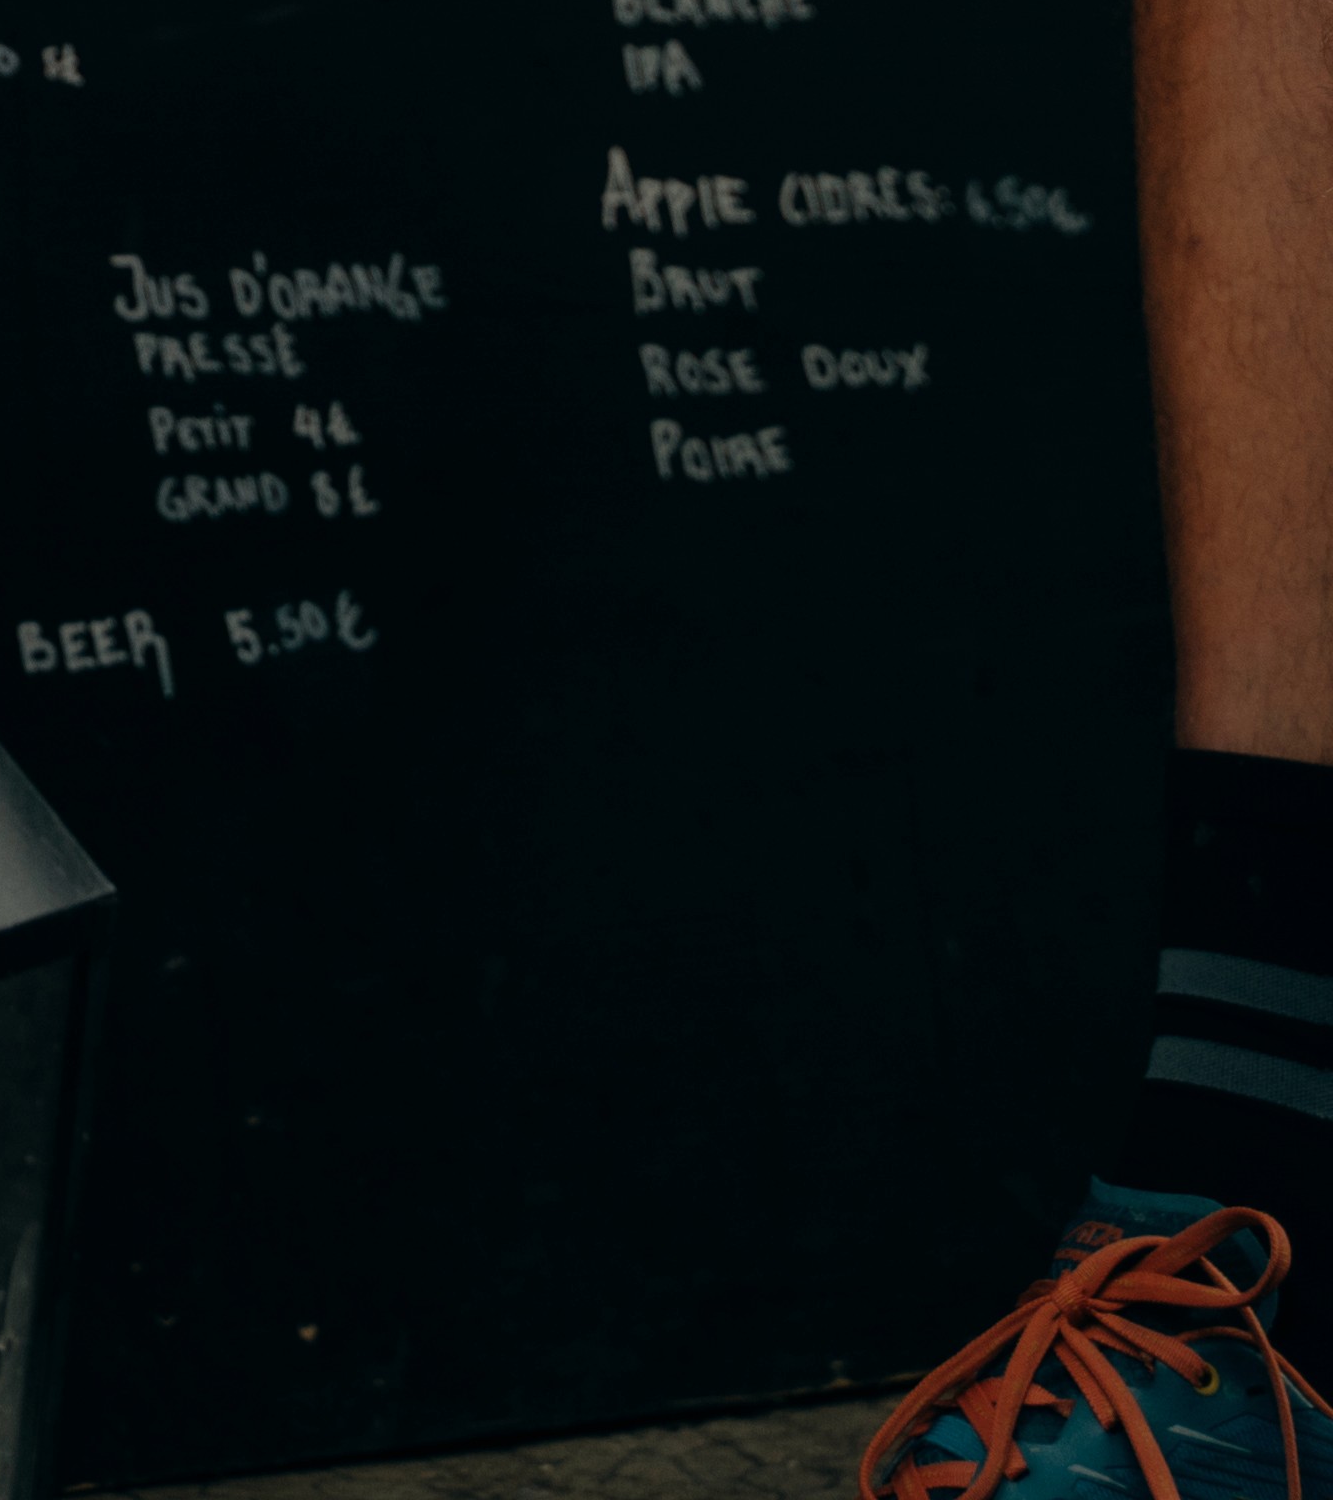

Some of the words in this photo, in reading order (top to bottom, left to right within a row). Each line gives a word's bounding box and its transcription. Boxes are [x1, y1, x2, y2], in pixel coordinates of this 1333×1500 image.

[109, 252, 208, 322] JUS
[629, 247, 764, 315] BRUT
[638, 341, 768, 397] ROSE
[800, 341, 932, 394] DOUX
[156, 470, 291, 523] GRAND
[15, 610, 174, 697] BEER
